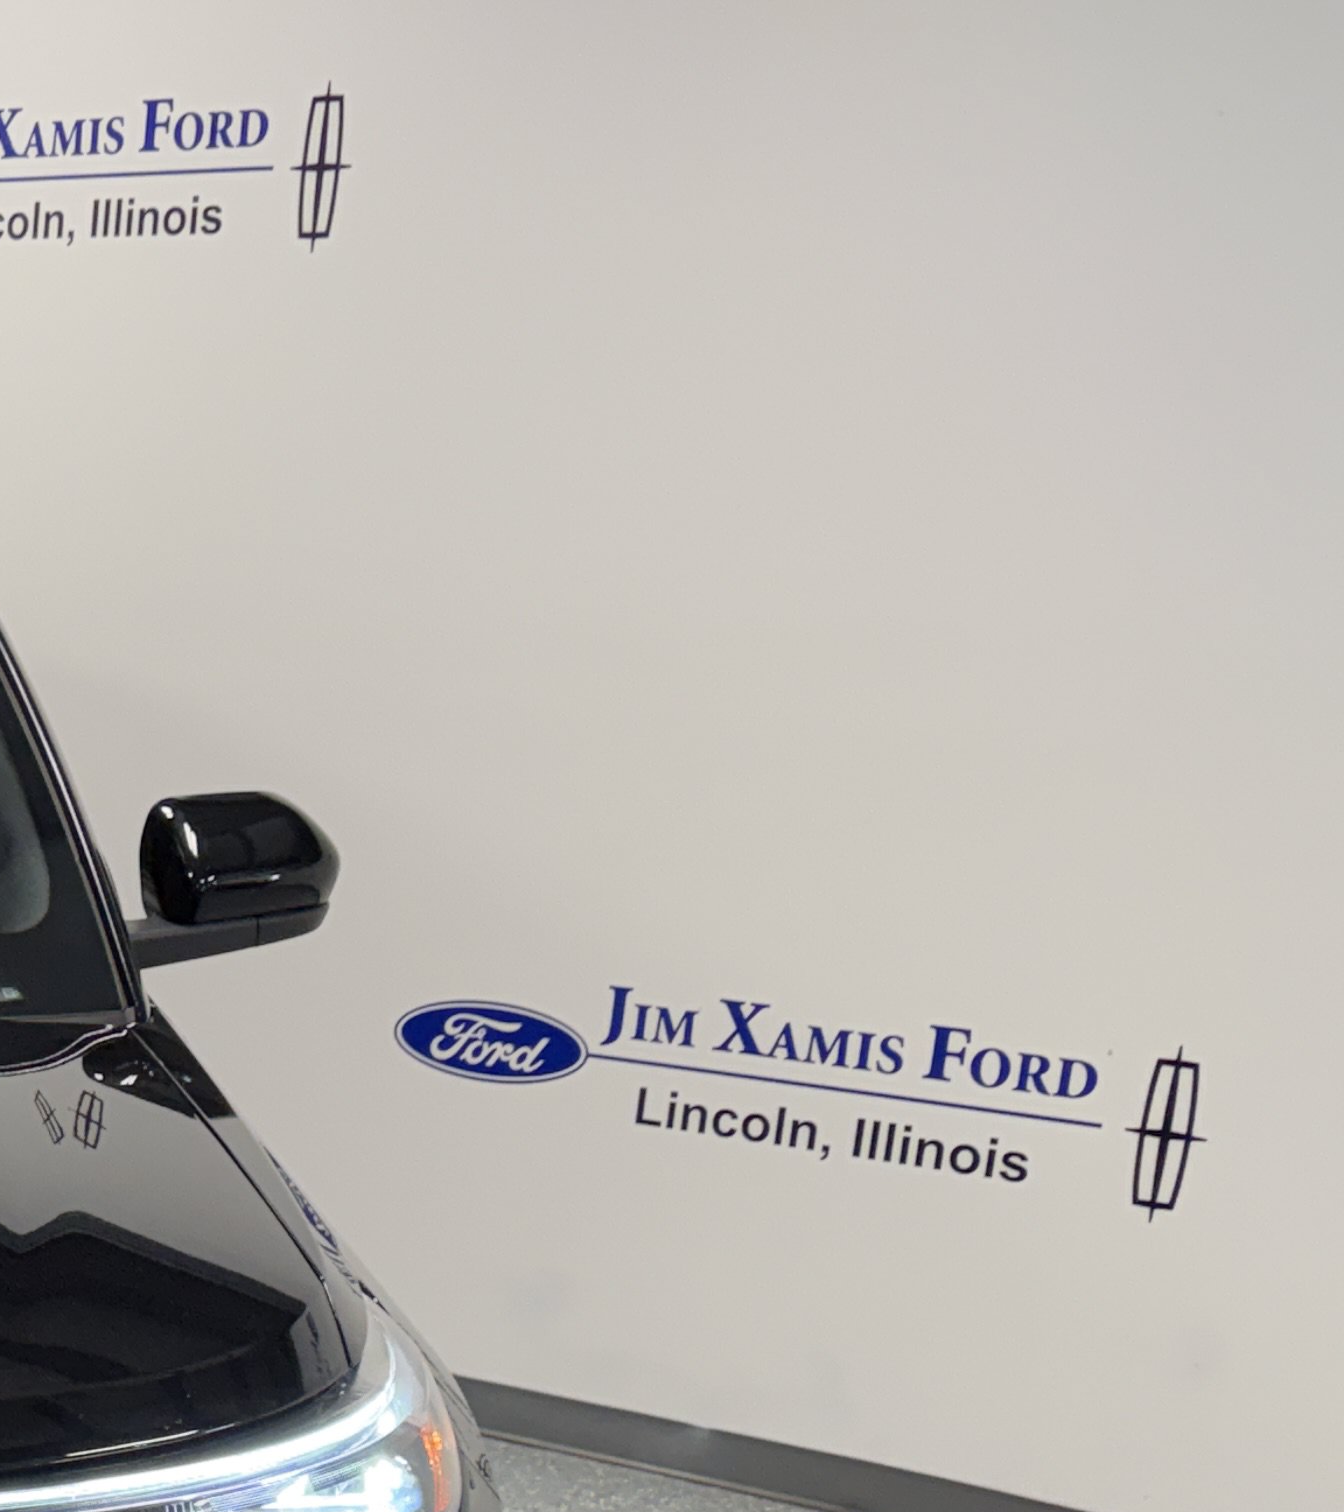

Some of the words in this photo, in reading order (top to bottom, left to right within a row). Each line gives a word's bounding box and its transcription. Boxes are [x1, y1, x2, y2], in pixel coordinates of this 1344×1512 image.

[140, 98, 269, 153] FORD
[90, 195, 223, 239] Illinois
[428, 1011, 548, 1074] Ford
[599, 984, 700, 1048] JIM
[712, 998, 905, 1074] XAMIS
[922, 1024, 1100, 1101] FORD
[633, 1087, 832, 1163] Lincoln,
[851, 1118, 1031, 1183] Illinois
